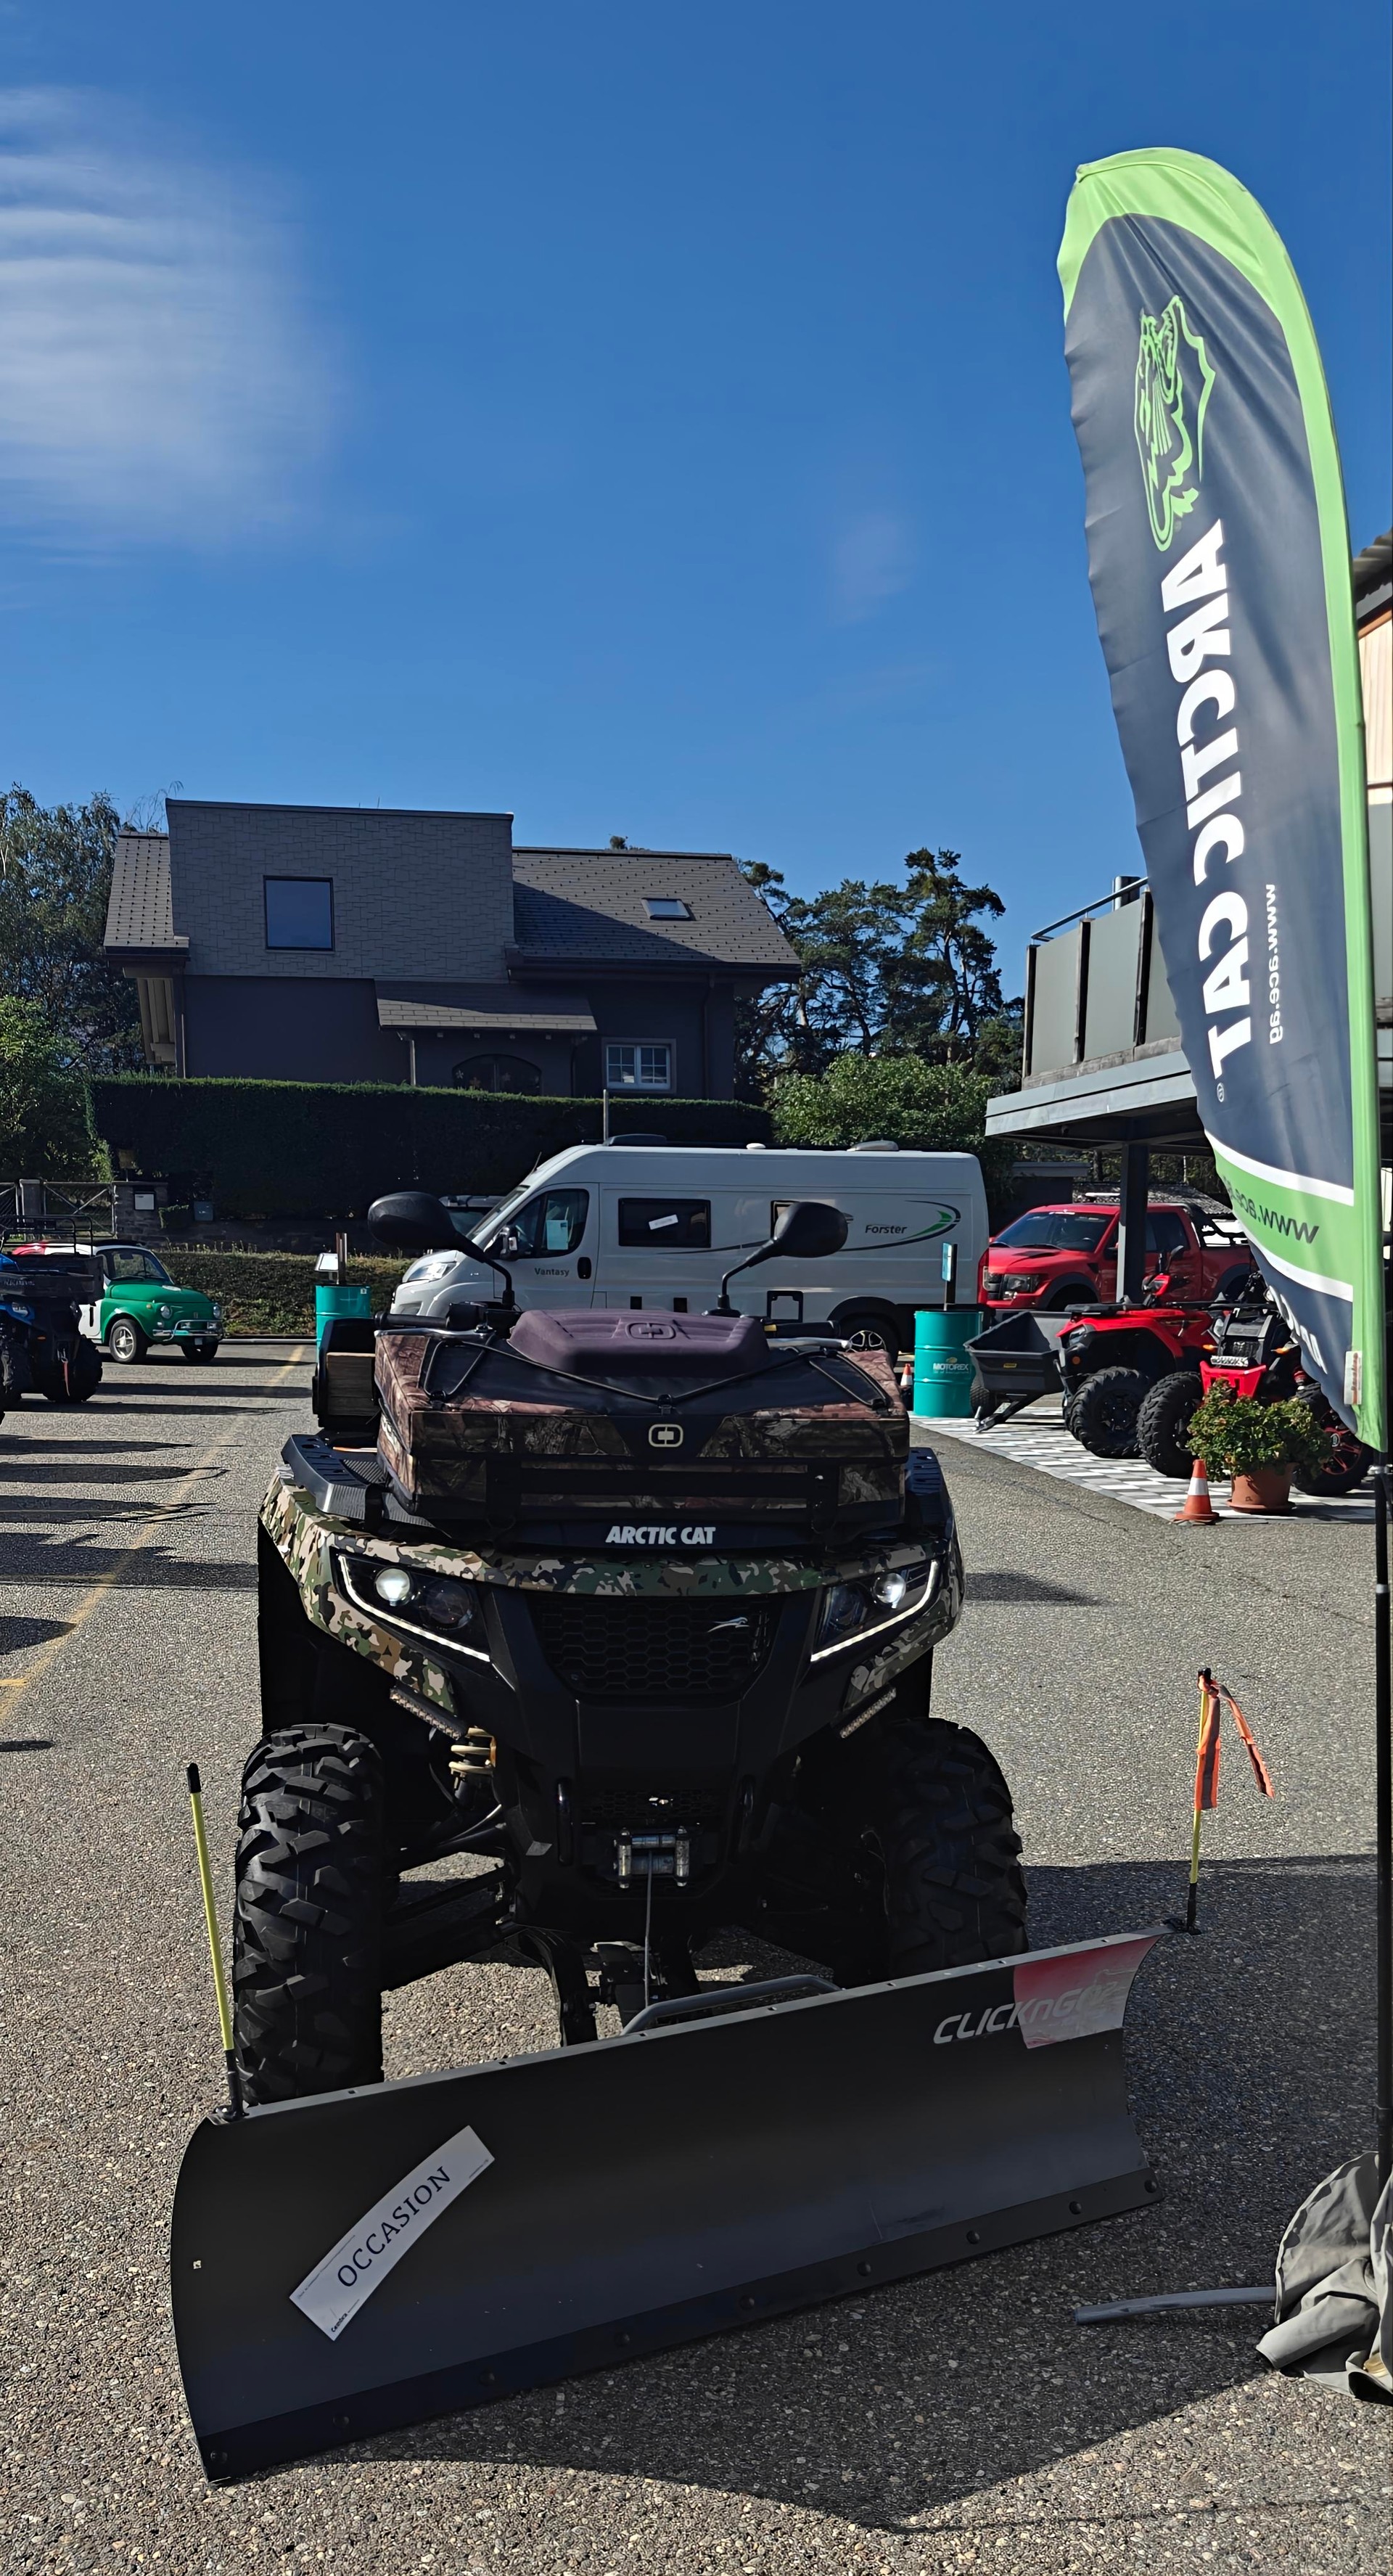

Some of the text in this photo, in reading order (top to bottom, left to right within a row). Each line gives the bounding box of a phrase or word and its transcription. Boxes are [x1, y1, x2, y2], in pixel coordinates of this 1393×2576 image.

[865, 1224, 908, 1234] Forster
[534, 1268, 570, 1278] Vantasy
[605, 1525, 716, 1545] ARCTIC CAT
[337, 2166, 451, 2286] OCCASION
